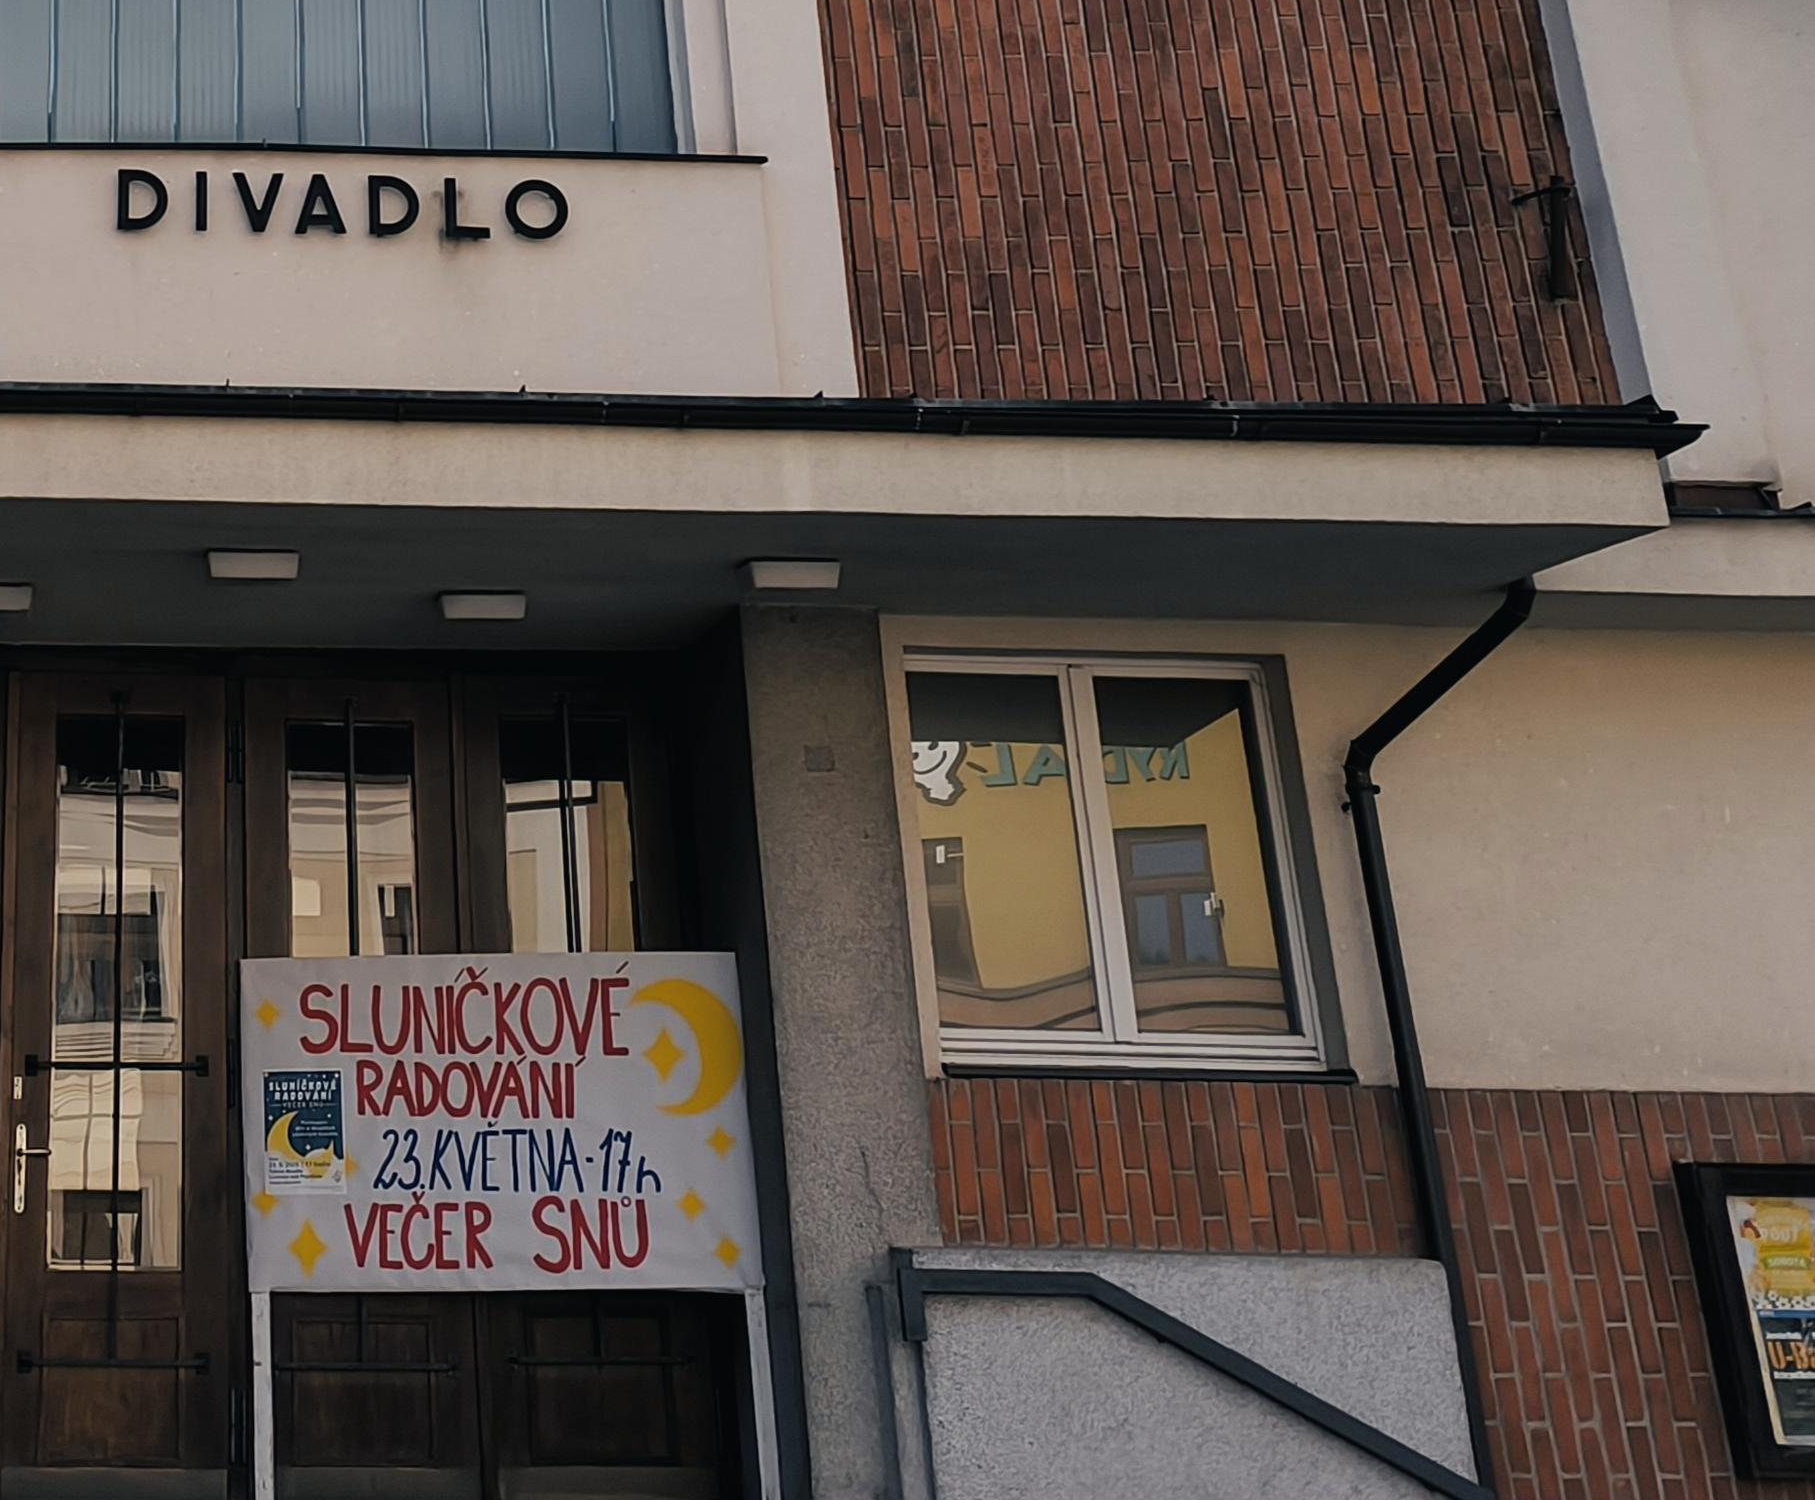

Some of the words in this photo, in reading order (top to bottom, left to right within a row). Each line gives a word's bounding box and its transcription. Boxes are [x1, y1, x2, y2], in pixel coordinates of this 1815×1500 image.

[116, 168, 569, 240] DIVADLO
[299, 961, 630, 1056] SLUNÍČKOVÉ
[355, 1055, 586, 1119] RADOVÁNÍ
[344, 1191, 494, 1270] VEČER
[532, 1195, 649, 1274] SNŮ
